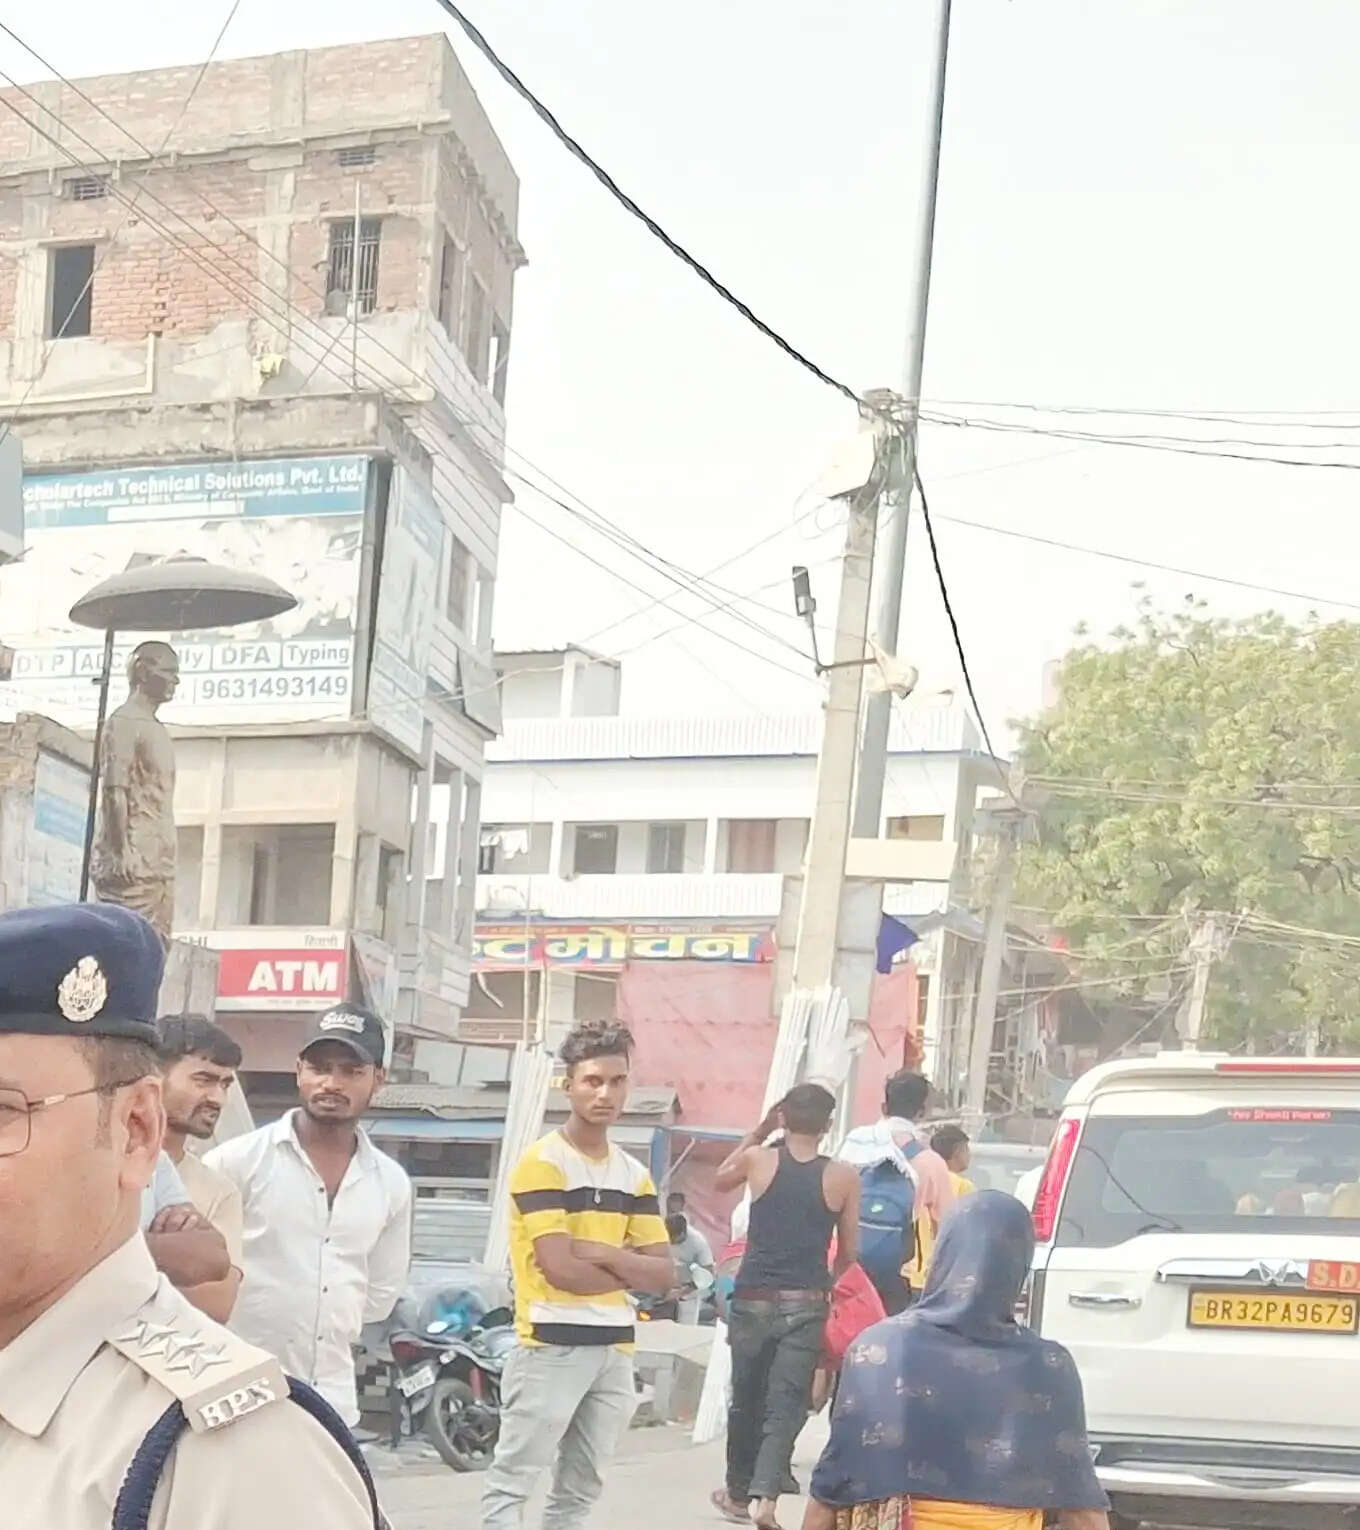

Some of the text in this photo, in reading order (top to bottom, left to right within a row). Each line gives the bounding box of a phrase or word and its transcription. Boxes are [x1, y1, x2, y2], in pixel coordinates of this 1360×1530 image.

[118, 473, 200, 496] Technical
[204, 471, 285, 491] Solutions
[290, 467, 323, 486] Pvt.
[328, 464, 363, 483] Ltd.
[221, 645, 271, 665] DFA
[287, 643, 350, 665] Typing
[201, 675, 349, 700] 9631493149
[247, 960, 339, 992] ATM
[1206, 1299, 1354, 1325] BR32PA9679
[198, 1377, 276, 1429] BPS
